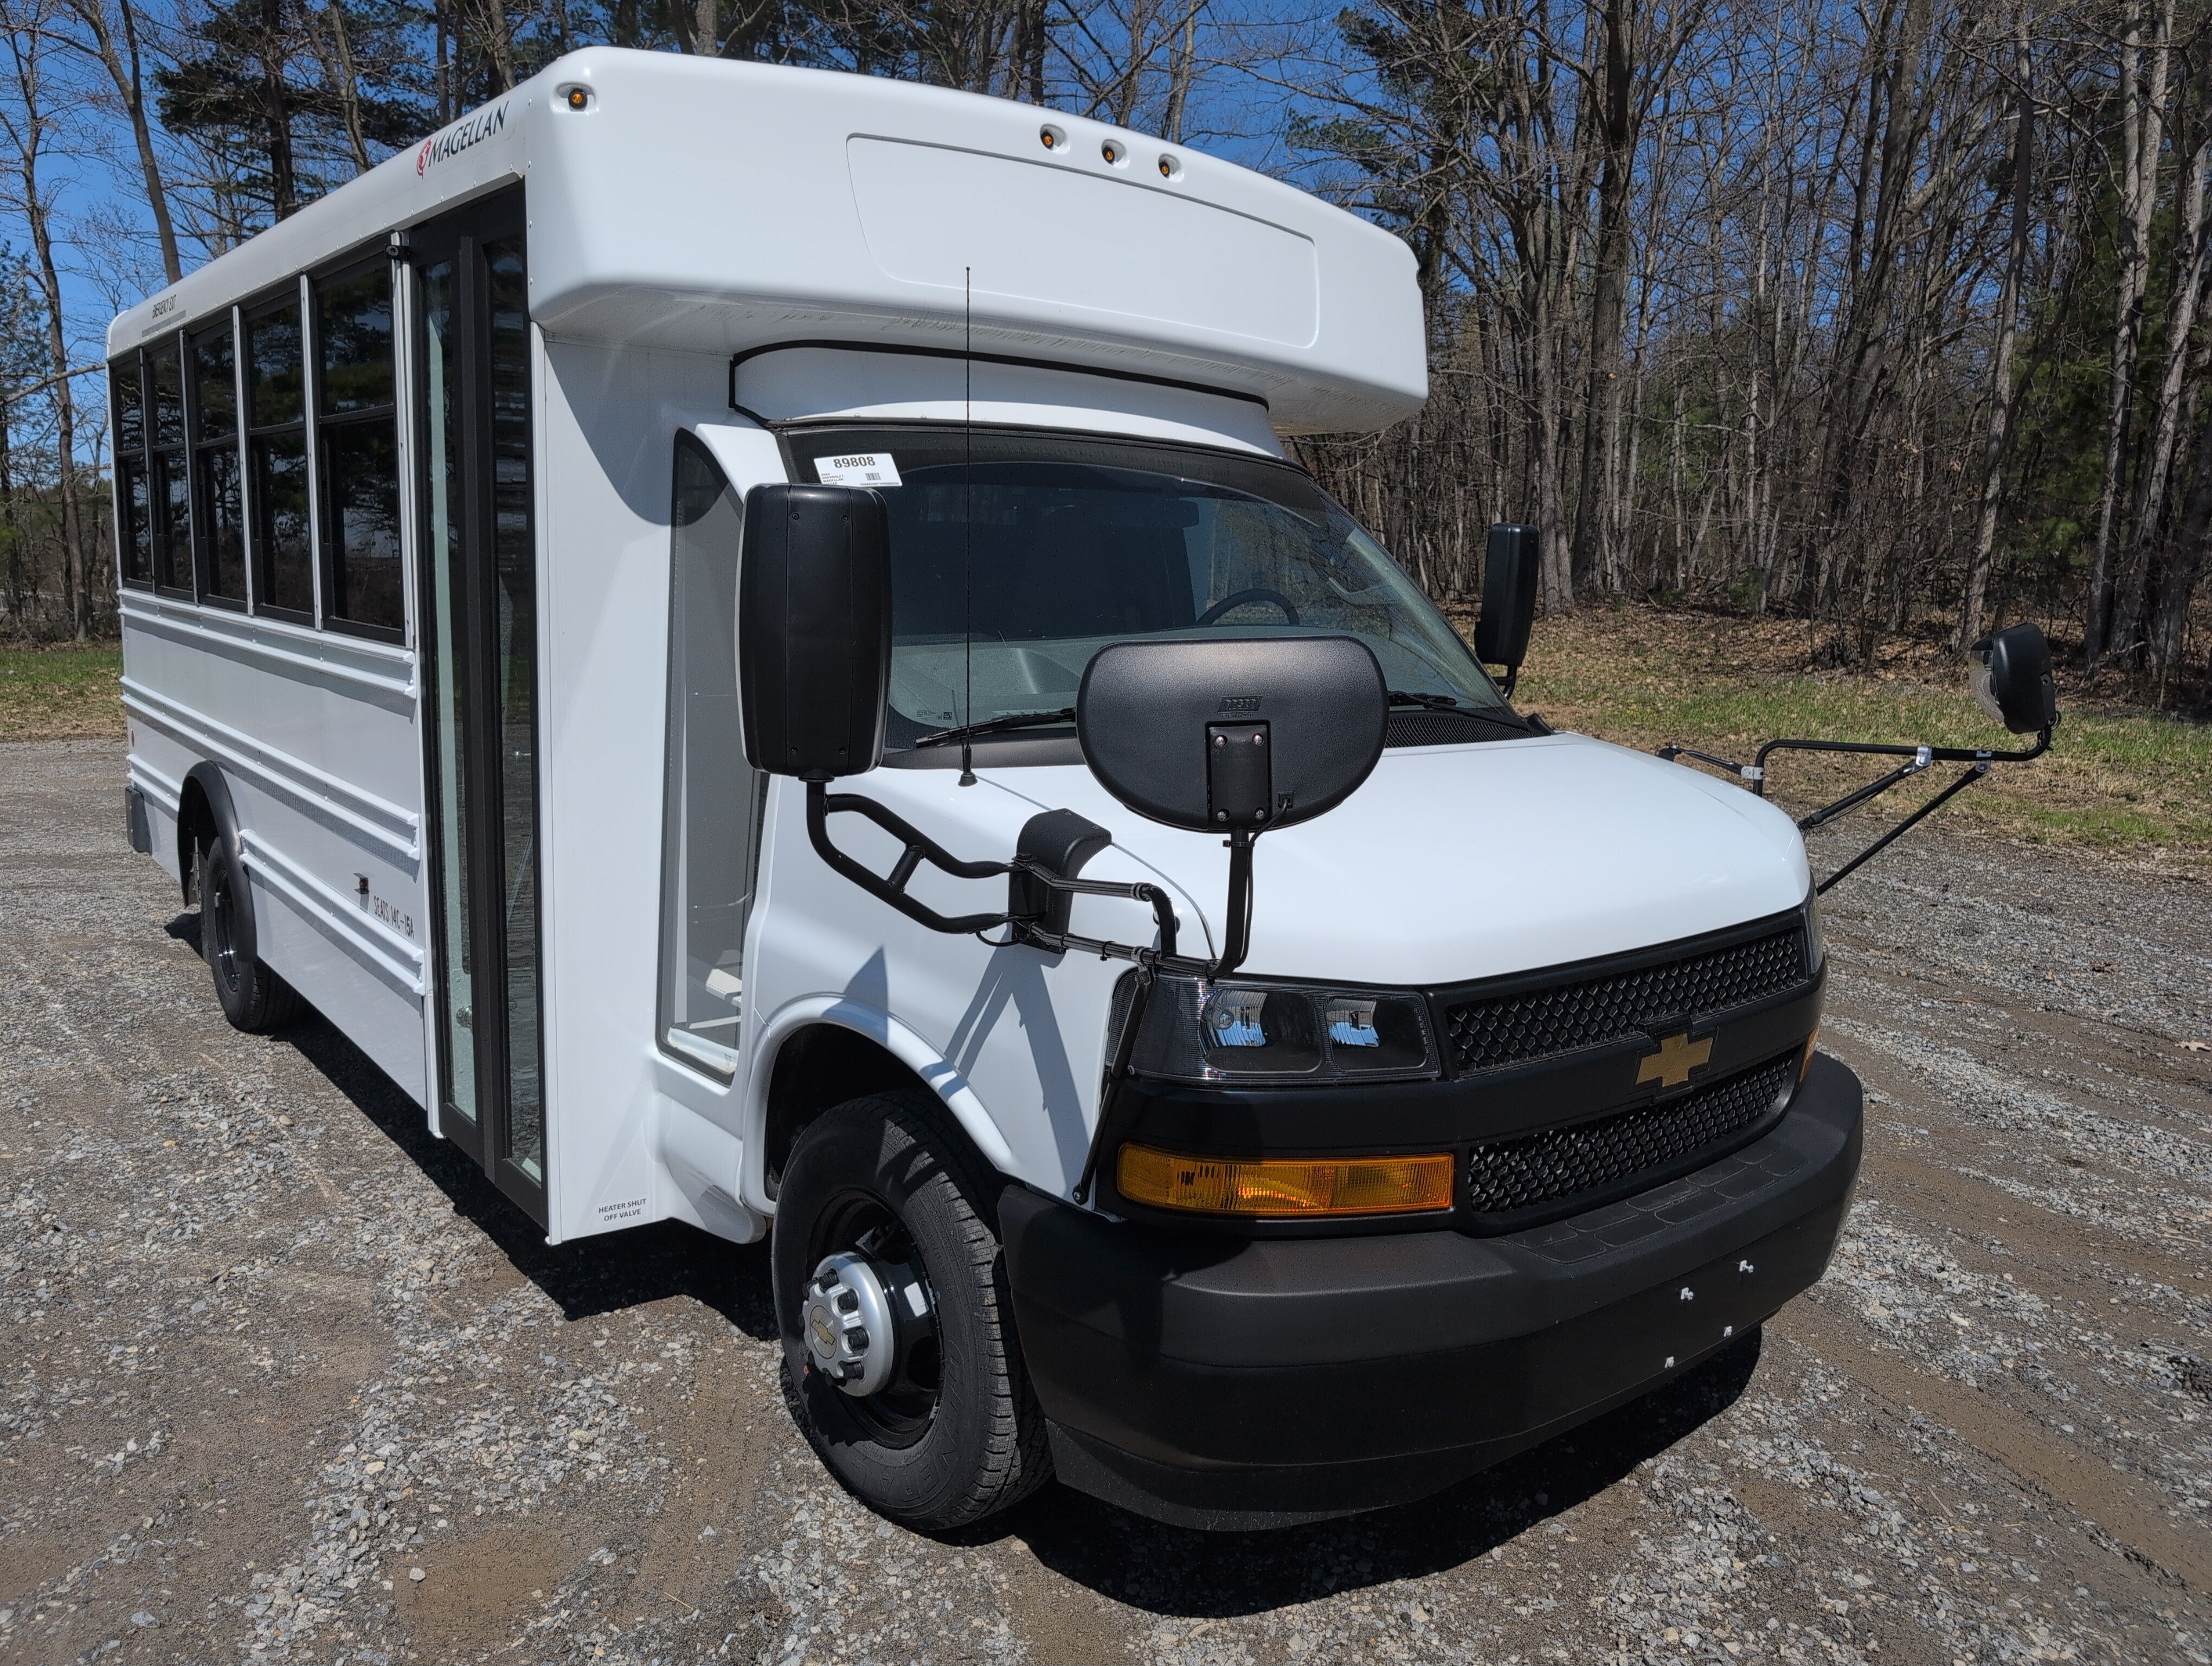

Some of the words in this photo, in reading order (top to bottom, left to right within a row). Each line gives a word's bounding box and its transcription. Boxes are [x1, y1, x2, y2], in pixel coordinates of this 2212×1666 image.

[428, 100, 510, 168] MAGELLAN
[833, 456, 876, 469] 89808
[374, 895, 389, 922] SEATS
[390, 905, 414, 940] 14C-15A
[599, 1202, 626, 1214] HEATER
[627, 1198, 647, 1208] SHUT
[604, 1213, 618, 1222] OFF
[619, 1208, 641, 1219] VALVE
